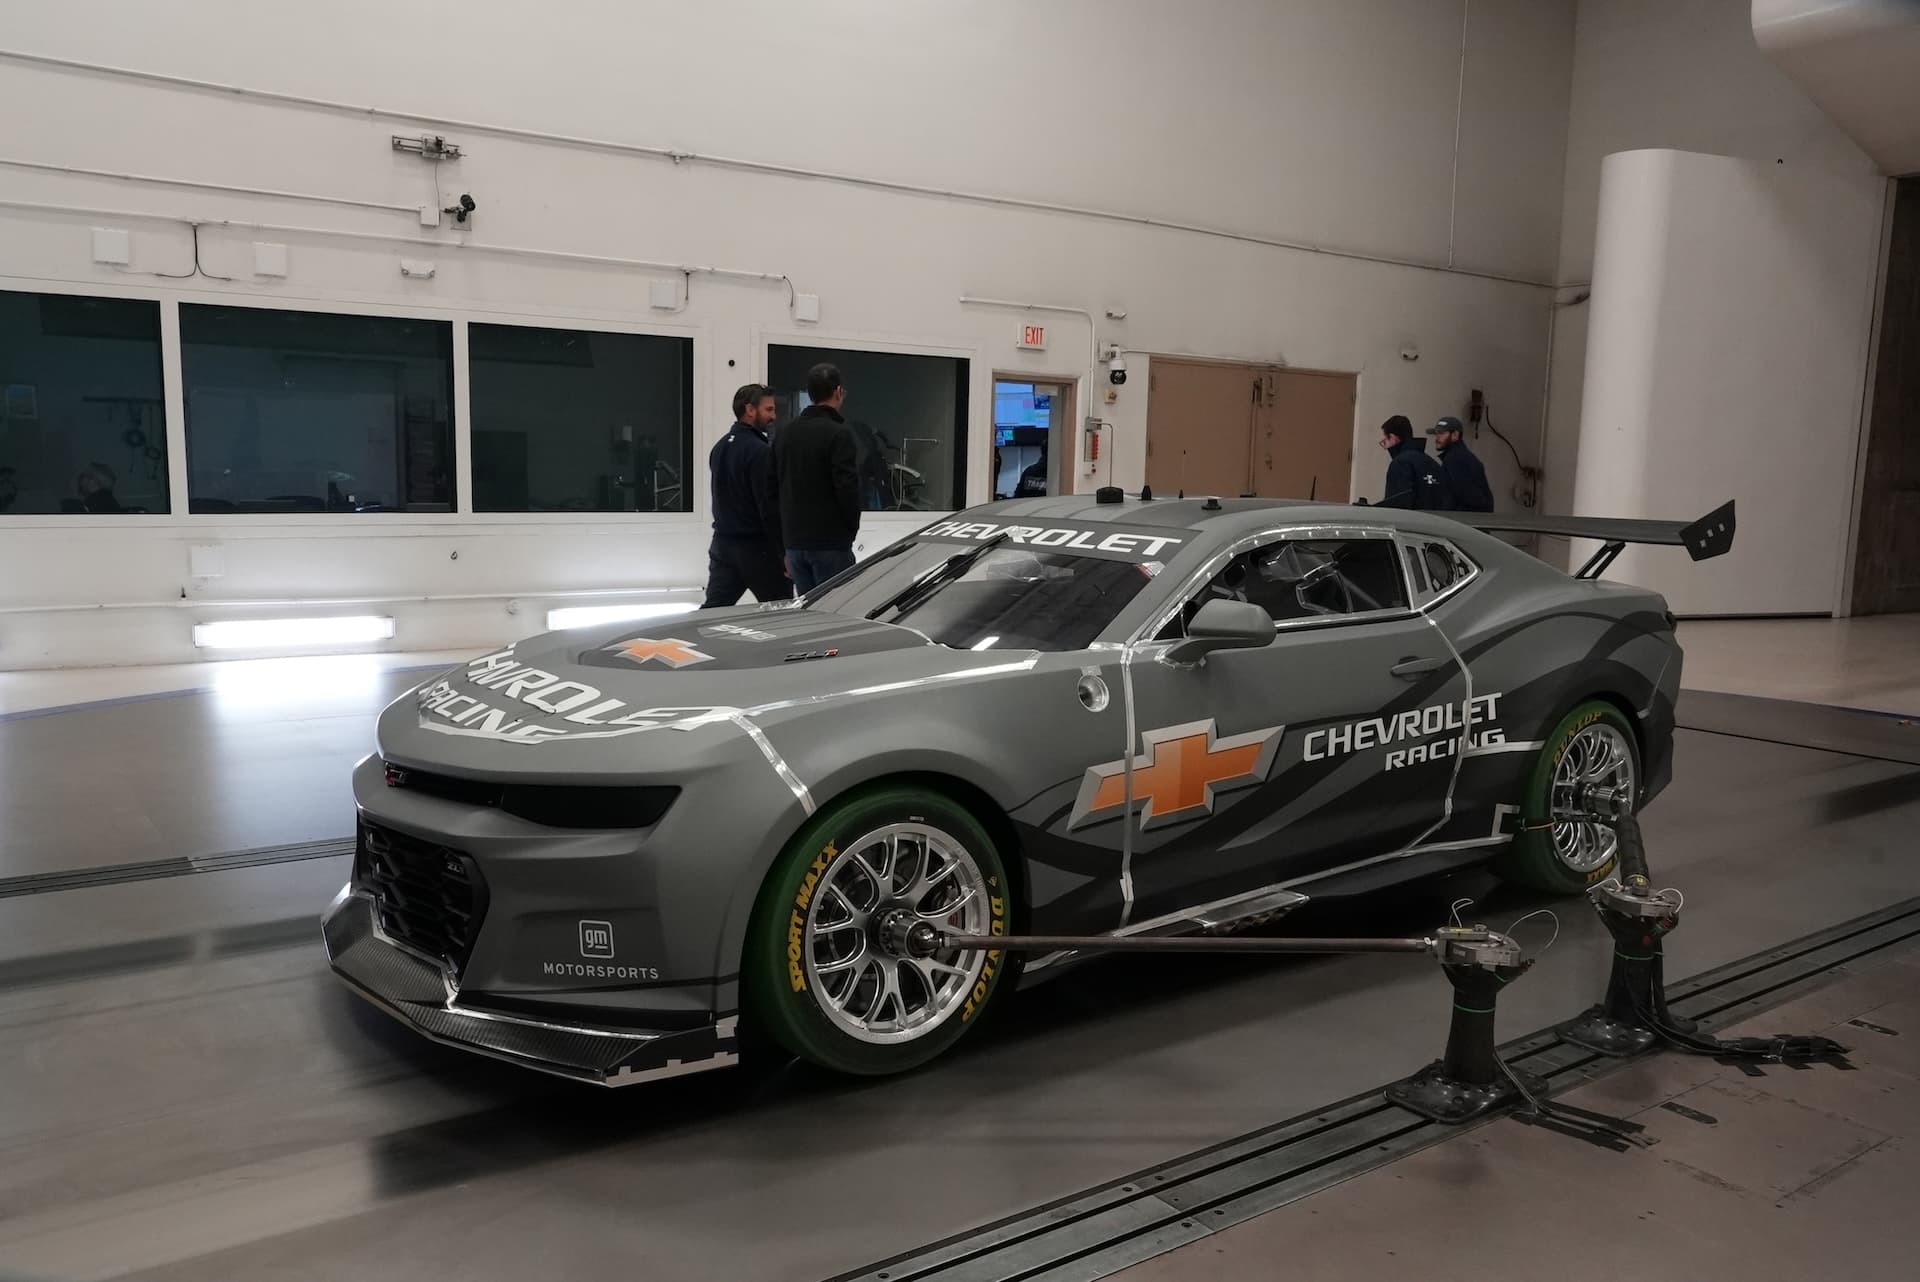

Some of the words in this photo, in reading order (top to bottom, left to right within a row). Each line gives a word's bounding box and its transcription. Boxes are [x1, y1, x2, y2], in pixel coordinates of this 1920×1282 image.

[1025, 326, 1044, 344] EXIT
[919, 521, 1182, 556] CHEVROLET
[1303, 692, 1502, 762] CHEVROLET
[1384, 728, 1505, 771] RACING
[796, 838, 839, 910] MAXX
[585, 929, 608, 949] gm
[788, 908, 807, 993] SPORT
[543, 962, 659, 979] MOTORSPORTS
